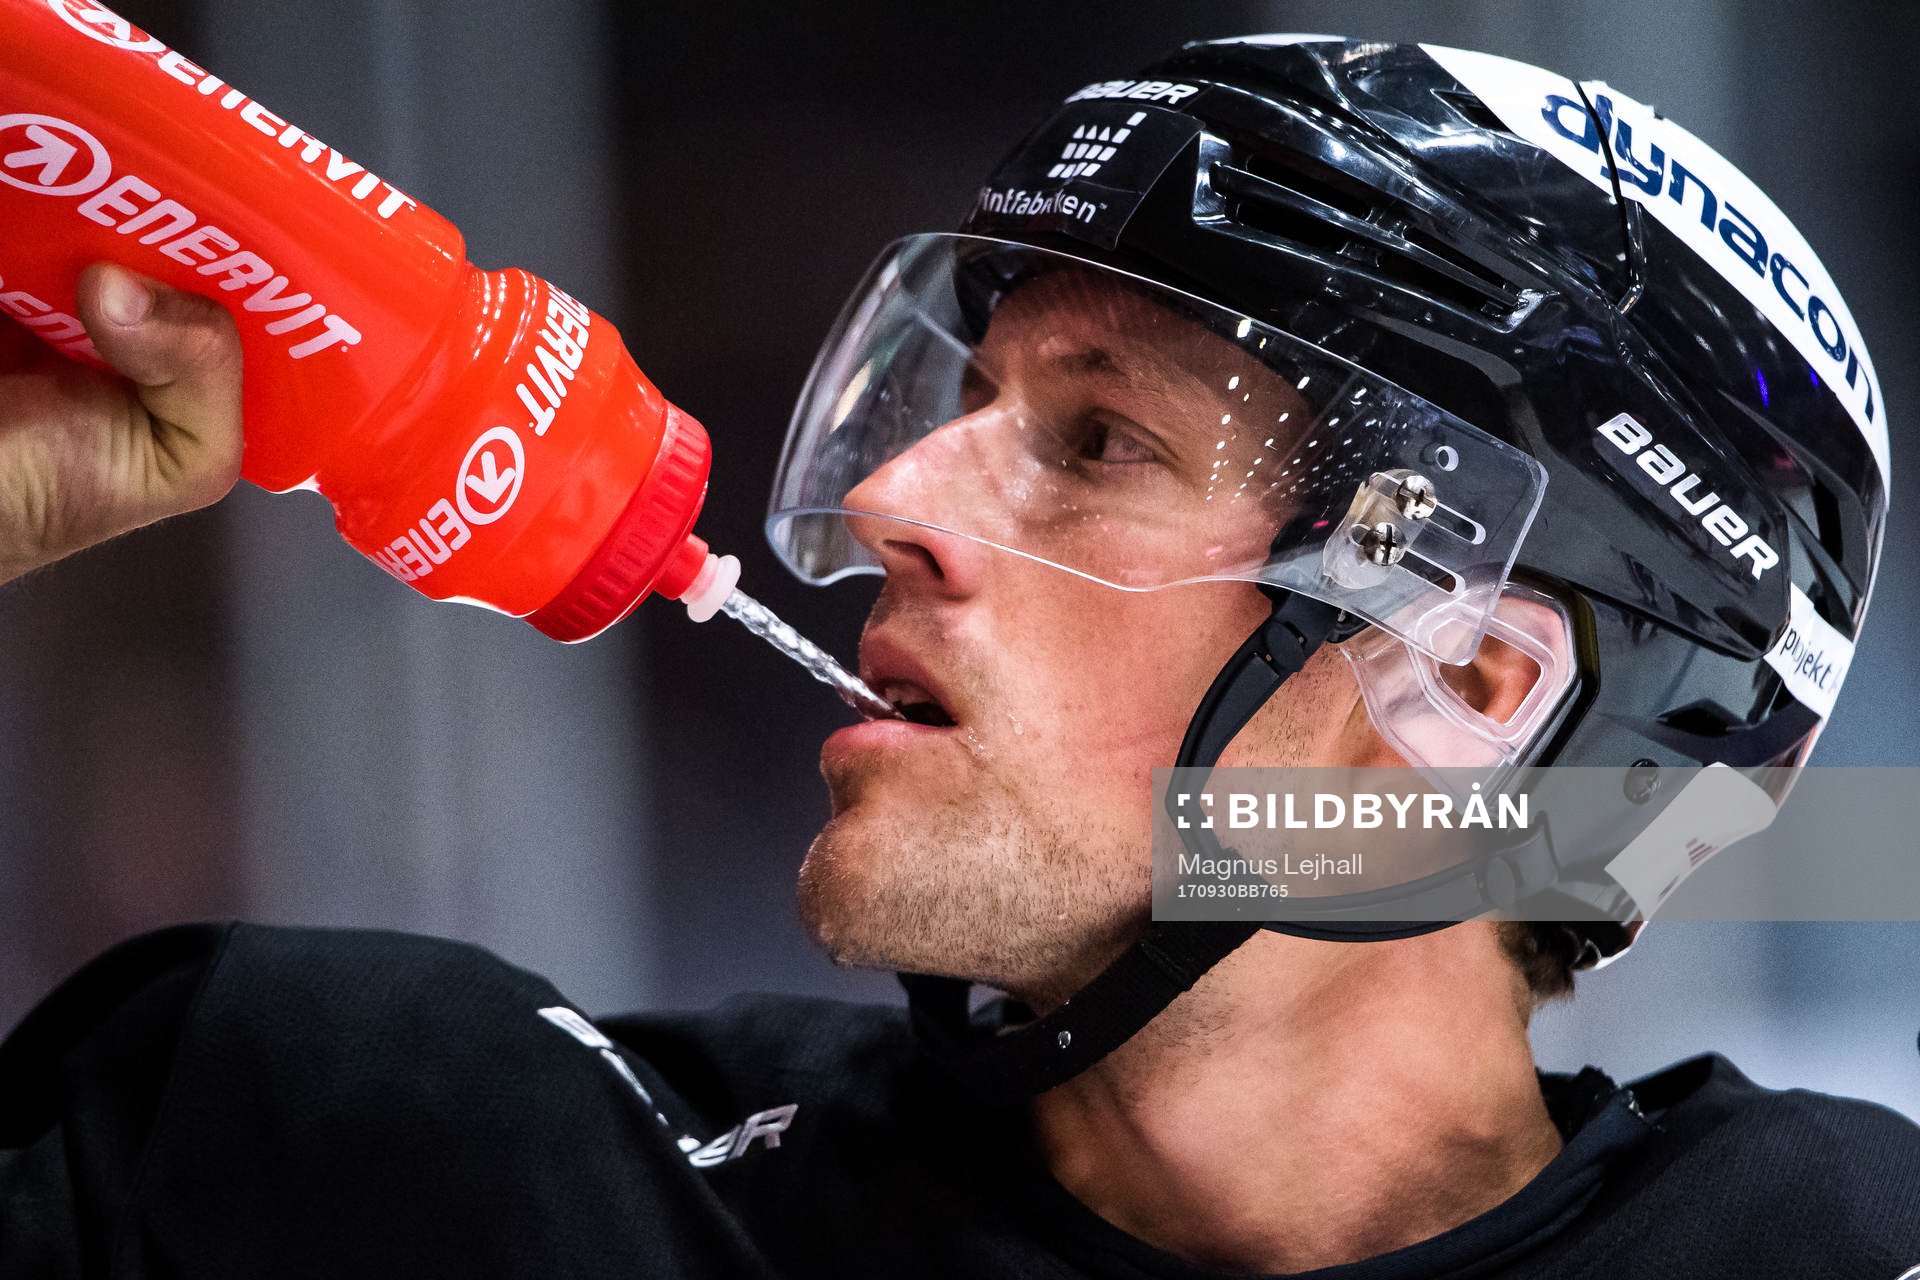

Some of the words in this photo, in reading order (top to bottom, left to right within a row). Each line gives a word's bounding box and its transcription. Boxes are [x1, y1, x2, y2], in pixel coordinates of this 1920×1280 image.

[157, 50, 413, 219] ENERVIT
[77, 175, 362, 360] ENERVIT
[1541, 94, 1874, 424] dynacon
[515, 280, 591, 437] ENERVIT
[367, 498, 472, 582] ENER
[1596, 412, 1780, 581] BAUER
